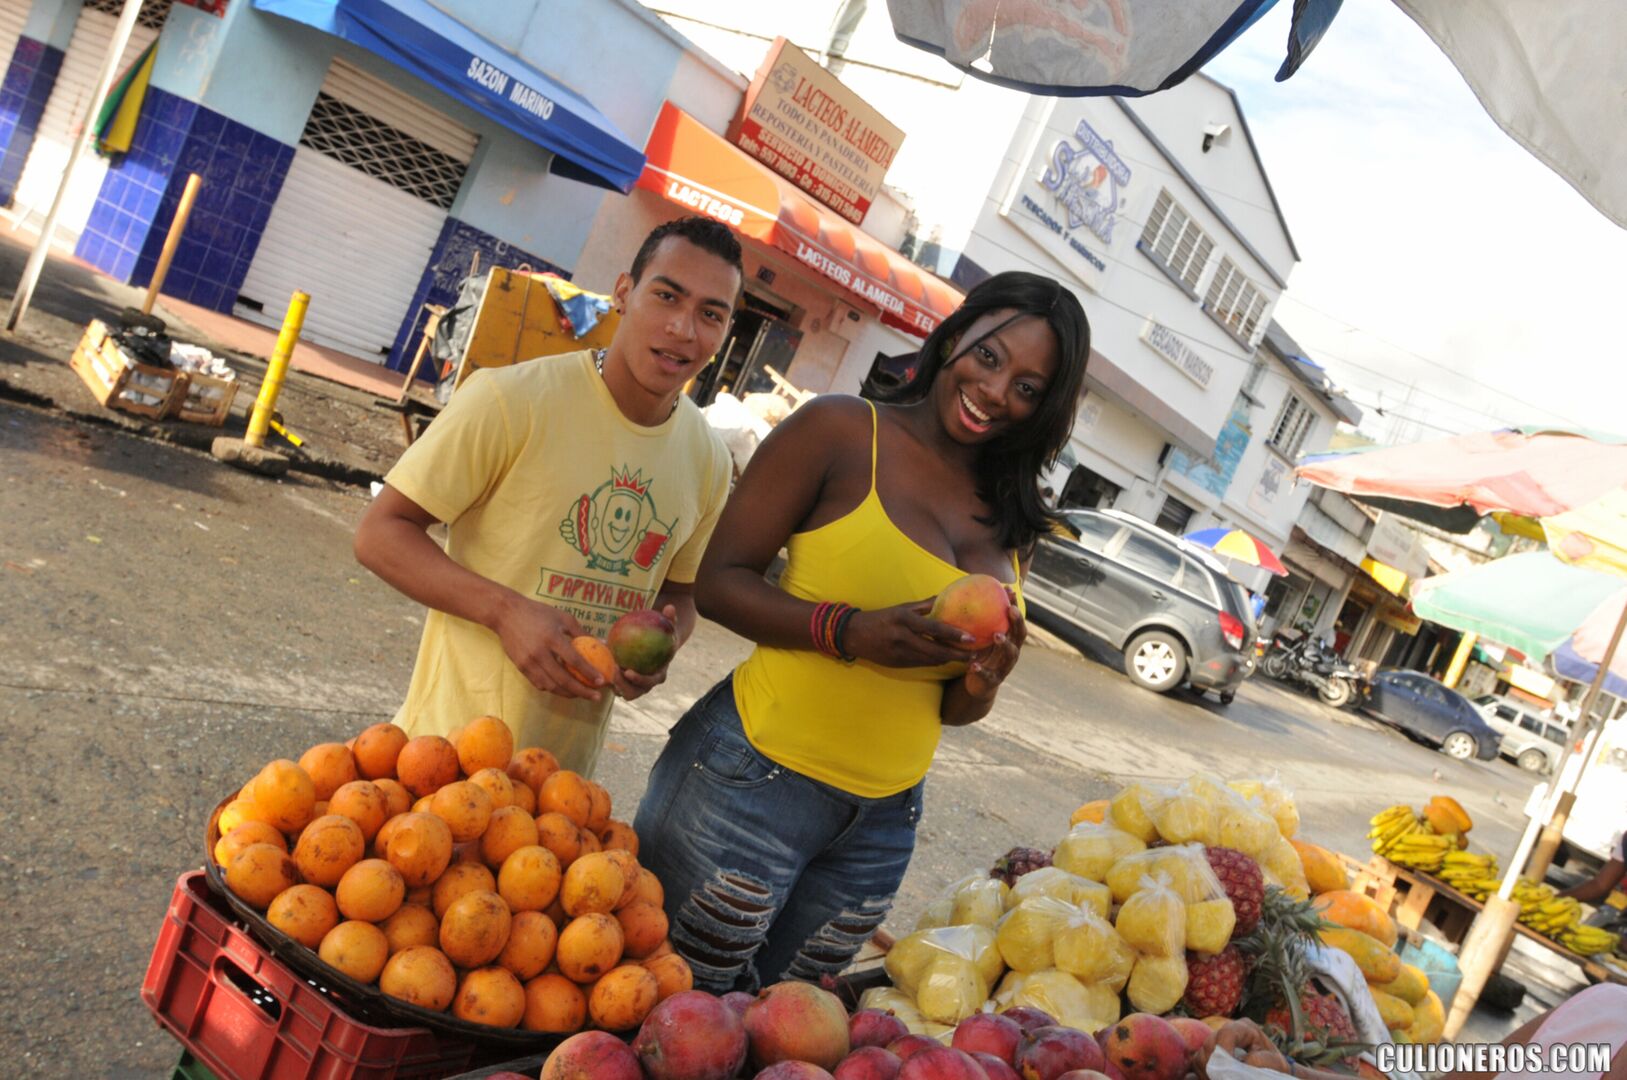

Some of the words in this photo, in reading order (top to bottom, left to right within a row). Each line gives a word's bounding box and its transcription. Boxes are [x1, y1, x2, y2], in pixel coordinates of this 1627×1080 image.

[467, 57, 509, 95] SAZON
[509, 82, 555, 121] MARINO
[775, 97, 806, 126] TODO
[804, 118, 820, 136] EN
[791, 75, 848, 133] LACTEOS
[840, 114, 896, 170] ALAMEDA
[757, 127, 805, 167] SERVICIO
[802, 159, 813, 172] A
[810, 164, 859, 205] DOMICILIO
[812, 144, 823, 158] Y
[668, 182, 744, 226] LACTEOS
[796, 243, 851, 287] LACTEOS
[852, 275, 905, 314] ALAMEDA
[547, 573, 614, 605] PAPAYA
[615, 587, 646, 610] KIN
